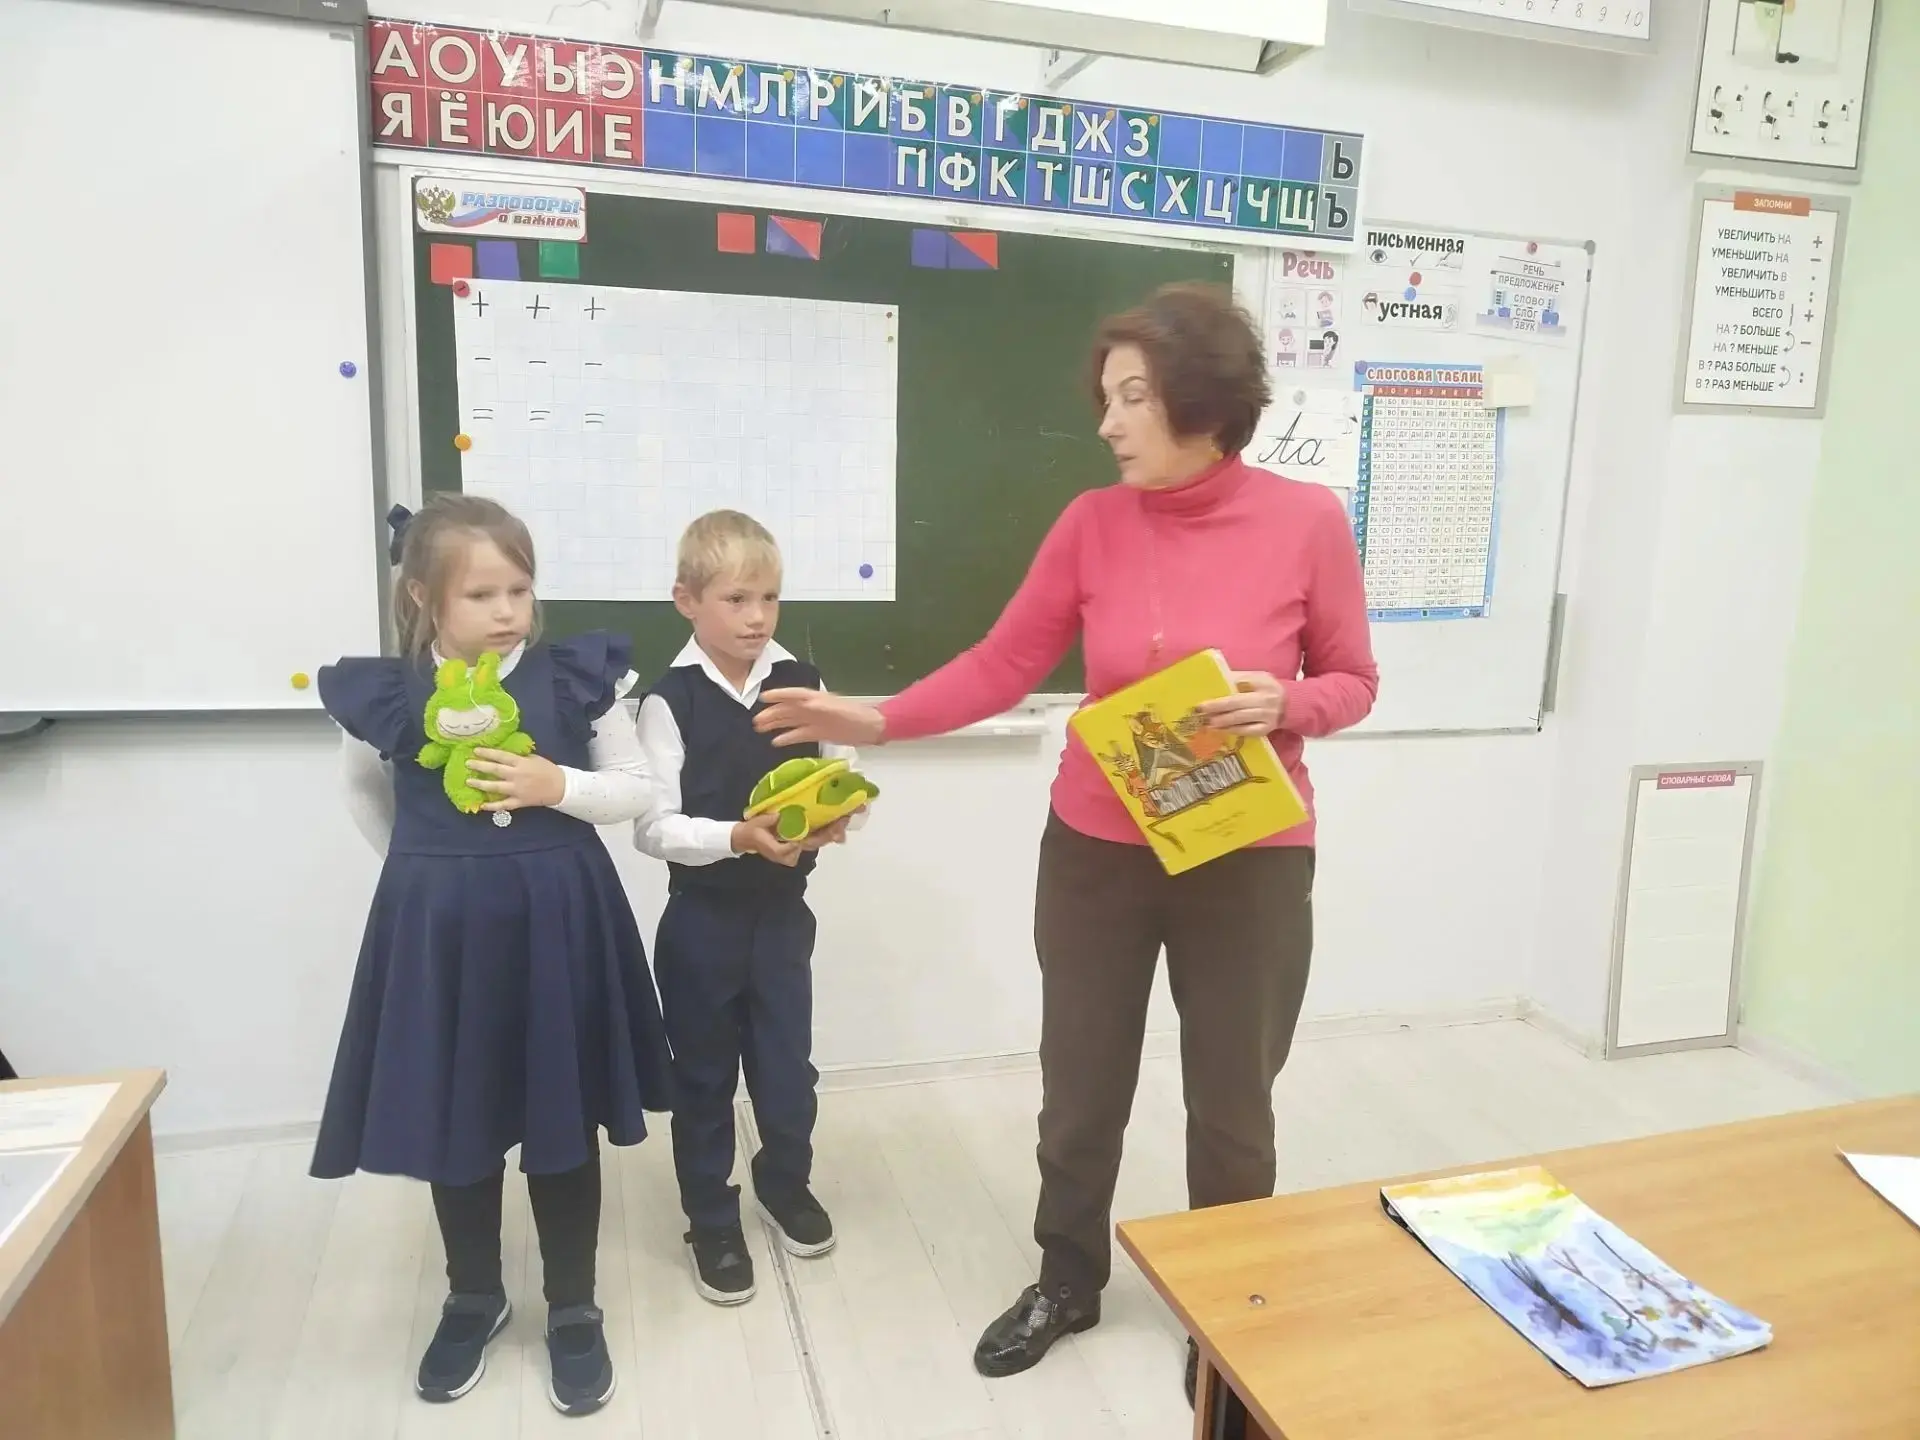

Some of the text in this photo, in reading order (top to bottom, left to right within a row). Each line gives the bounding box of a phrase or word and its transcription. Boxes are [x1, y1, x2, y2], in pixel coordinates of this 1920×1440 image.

[1575, 3, 1584, 18] 8
[1598, 6, 1608, 21] 9
[1624, 9, 1644, 27] 10
[373, 30, 420, 78] А
[429, 35, 478, 84] О
[489, 36, 527, 87] У
[544, 47, 587, 95] Ы
[601, 52, 635, 100] Э
[650, 59, 686, 106] Н
[697, 65, 743, 112] М
[752, 72, 788, 117] Л
[809, 72, 836, 121] Р
[901, 90, 927, 133] Б
[948, 95, 973, 137] В
[1031, 107, 1067, 154] Д
[1074, 111, 1113, 154] Ж
[1124, 118, 1149, 157] З
[380, 92, 413, 138] Я
[440, 91, 469, 144] Ё
[487, 102, 536, 150] Ю
[546, 108, 583, 155] И
[604, 113, 632, 160] Е
[897, 146, 927, 188] П
[939, 152, 976, 192] Ф
[989, 156, 1019, 198] К
[1037, 161, 1063, 202] Т
[1072, 164, 1112, 207] Ш
[1120, 171, 1147, 211] С
[1160, 175, 1191, 215] Х
[1203, 179, 1232, 224] Ц
[1247, 183, 1270, 223] Ч
[1279, 187, 1315, 232] Щ
[461, 192, 580, 214] РАЗГОВОРЫ
[1754, 198, 1792, 210] ЗАПОМНИ
[498, 214, 580, 229] о важном
[1367, 231, 1464, 254] письменная
[1718, 228, 1792, 245] УВЕЛИЧИТЬ НА
[1711, 248, 1789, 264] УМЕНЬШИТЬ НА
[1282, 252, 1335, 280] Речь
[1523, 264, 1544, 276] РЕЧЬ
[1721, 267, 1788, 282] УВЕЛИЧИТЬ В
[1499, 275, 1559, 293] ПРЕДЛОЖЕНИЕ
[1514, 294, 1544, 306] СЛОВО
[1714, 285, 1785, 301] УМЕНЬШИТЬ В
[1377, 301, 1443, 322] устная
[1515, 308, 1538, 318] СЛОГ
[1752, 307, 1784, 319] ВСЕГО
[1515, 321, 1536, 331] ЗВУК
[1716, 323, 1730, 335] НА
[1740, 324, 1781, 338] БОЛЬШЕ
[1713, 341, 1727, 352] НА
[1737, 343, 1779, 356] МЕНЬШЕ
[1698, 359, 1705, 371] В
[1714, 361, 1734, 372] РАЗ
[1735, 361, 1777, 374] БОЛЬШЕ
[1367, 368, 1433, 381] СЛОГОВАЯ
[1695, 378, 1702, 389] В
[1712, 379, 1731, 390] РАЗ
[1732, 379, 1775, 392] МЕНЬШЕ
[1258, 411, 1325, 465] Аа
[1661, 774, 1732, 785] СЛОВАРНЫЕ СЛОВА
